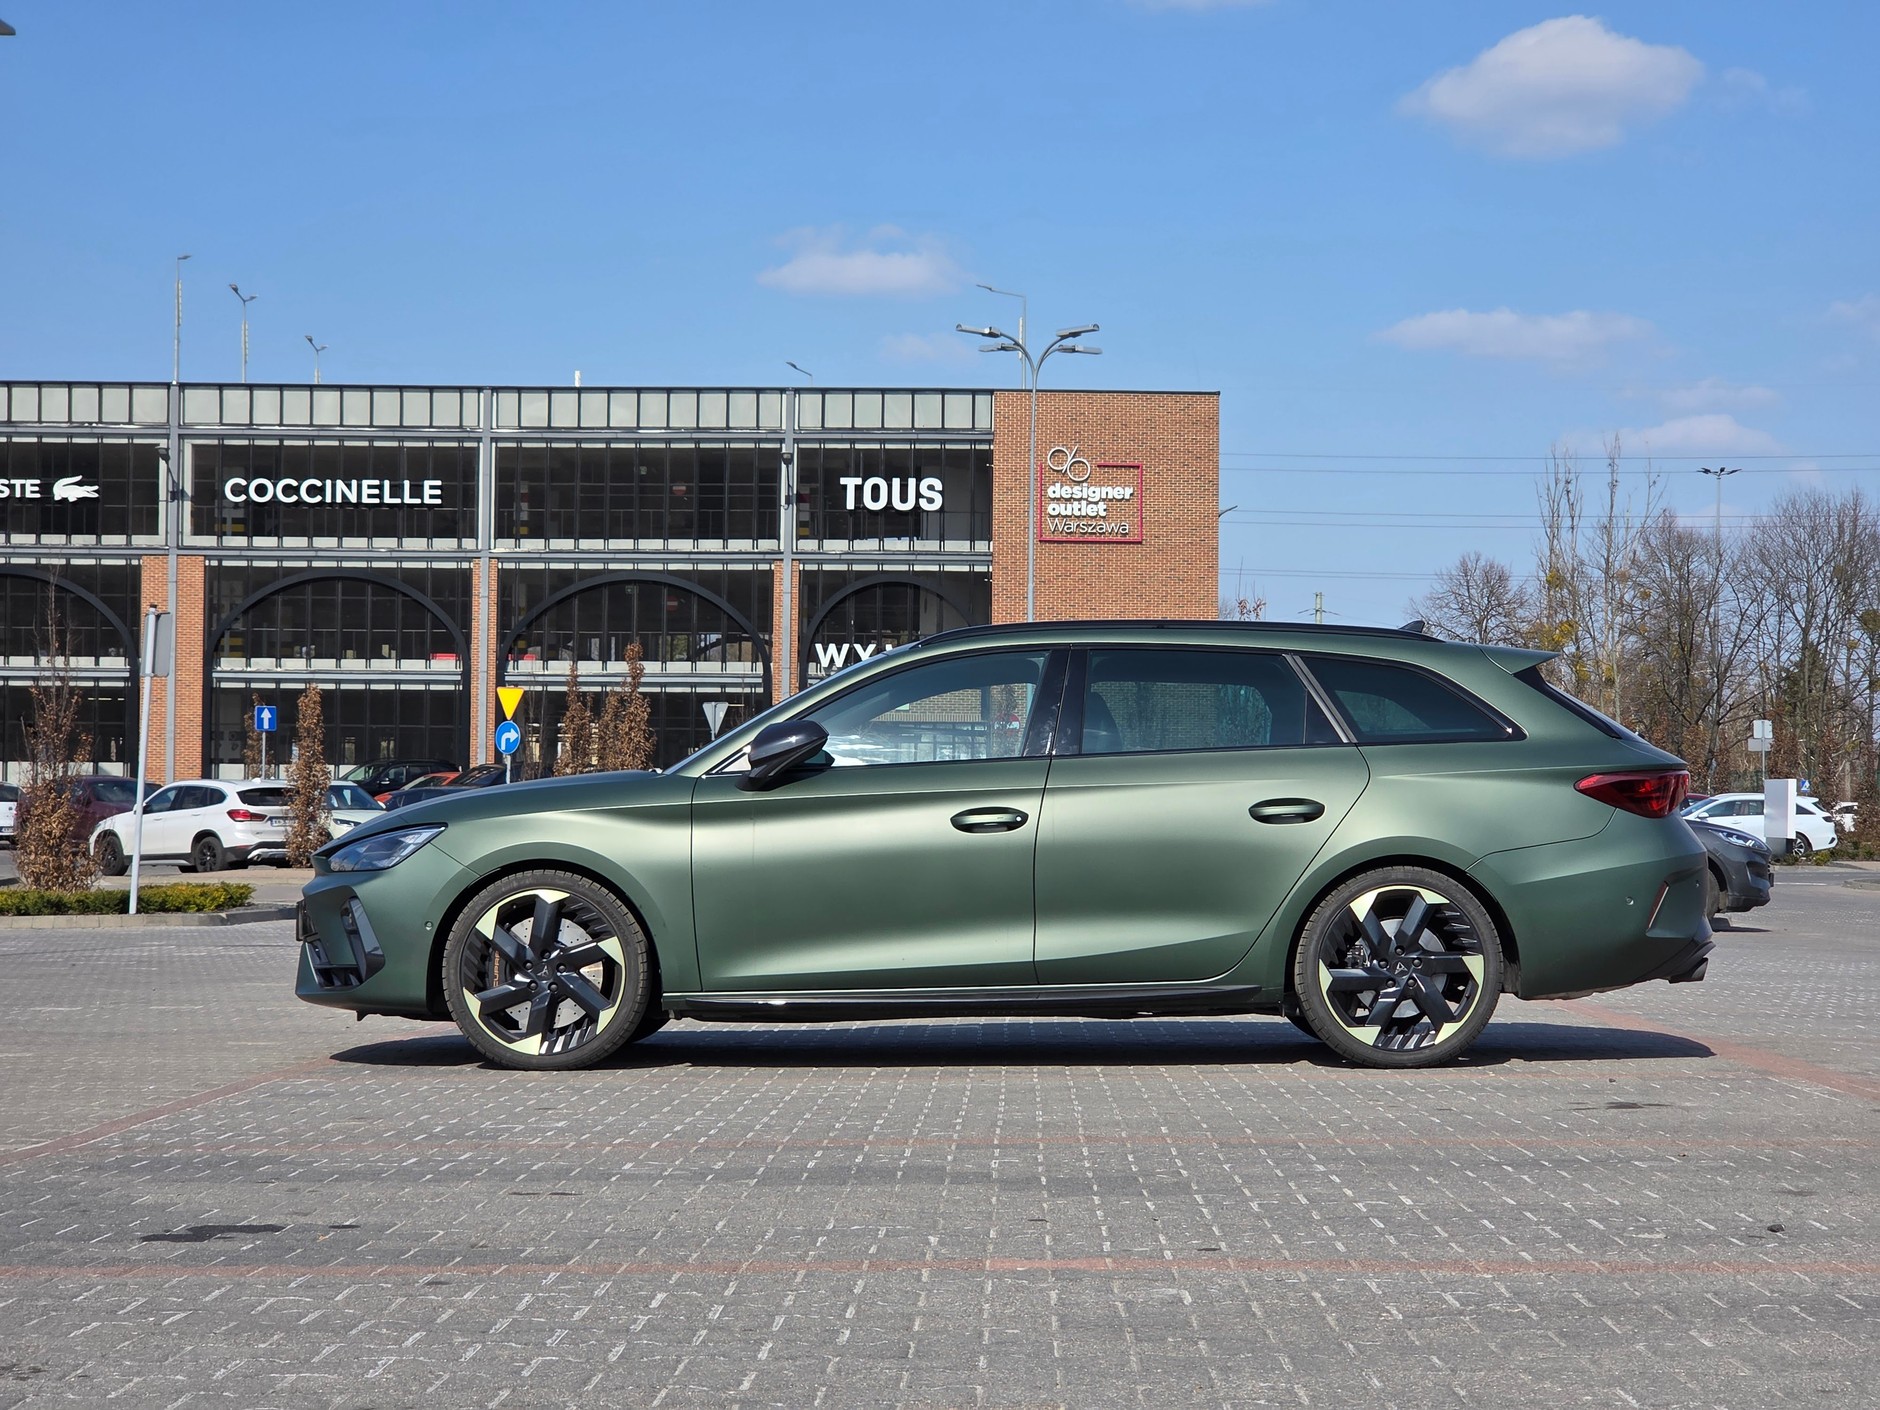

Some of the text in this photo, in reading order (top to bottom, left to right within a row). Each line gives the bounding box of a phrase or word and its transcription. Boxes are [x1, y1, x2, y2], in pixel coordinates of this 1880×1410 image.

[224, 477, 443, 504] COCCINELLE
[839, 476, 943, 511] TOUS
[1047, 483, 1134, 502] designer
[1047, 501, 1107, 516] outlet
[1047, 517, 1129, 534] Warszawa
[814, 643, 893, 668] WY
